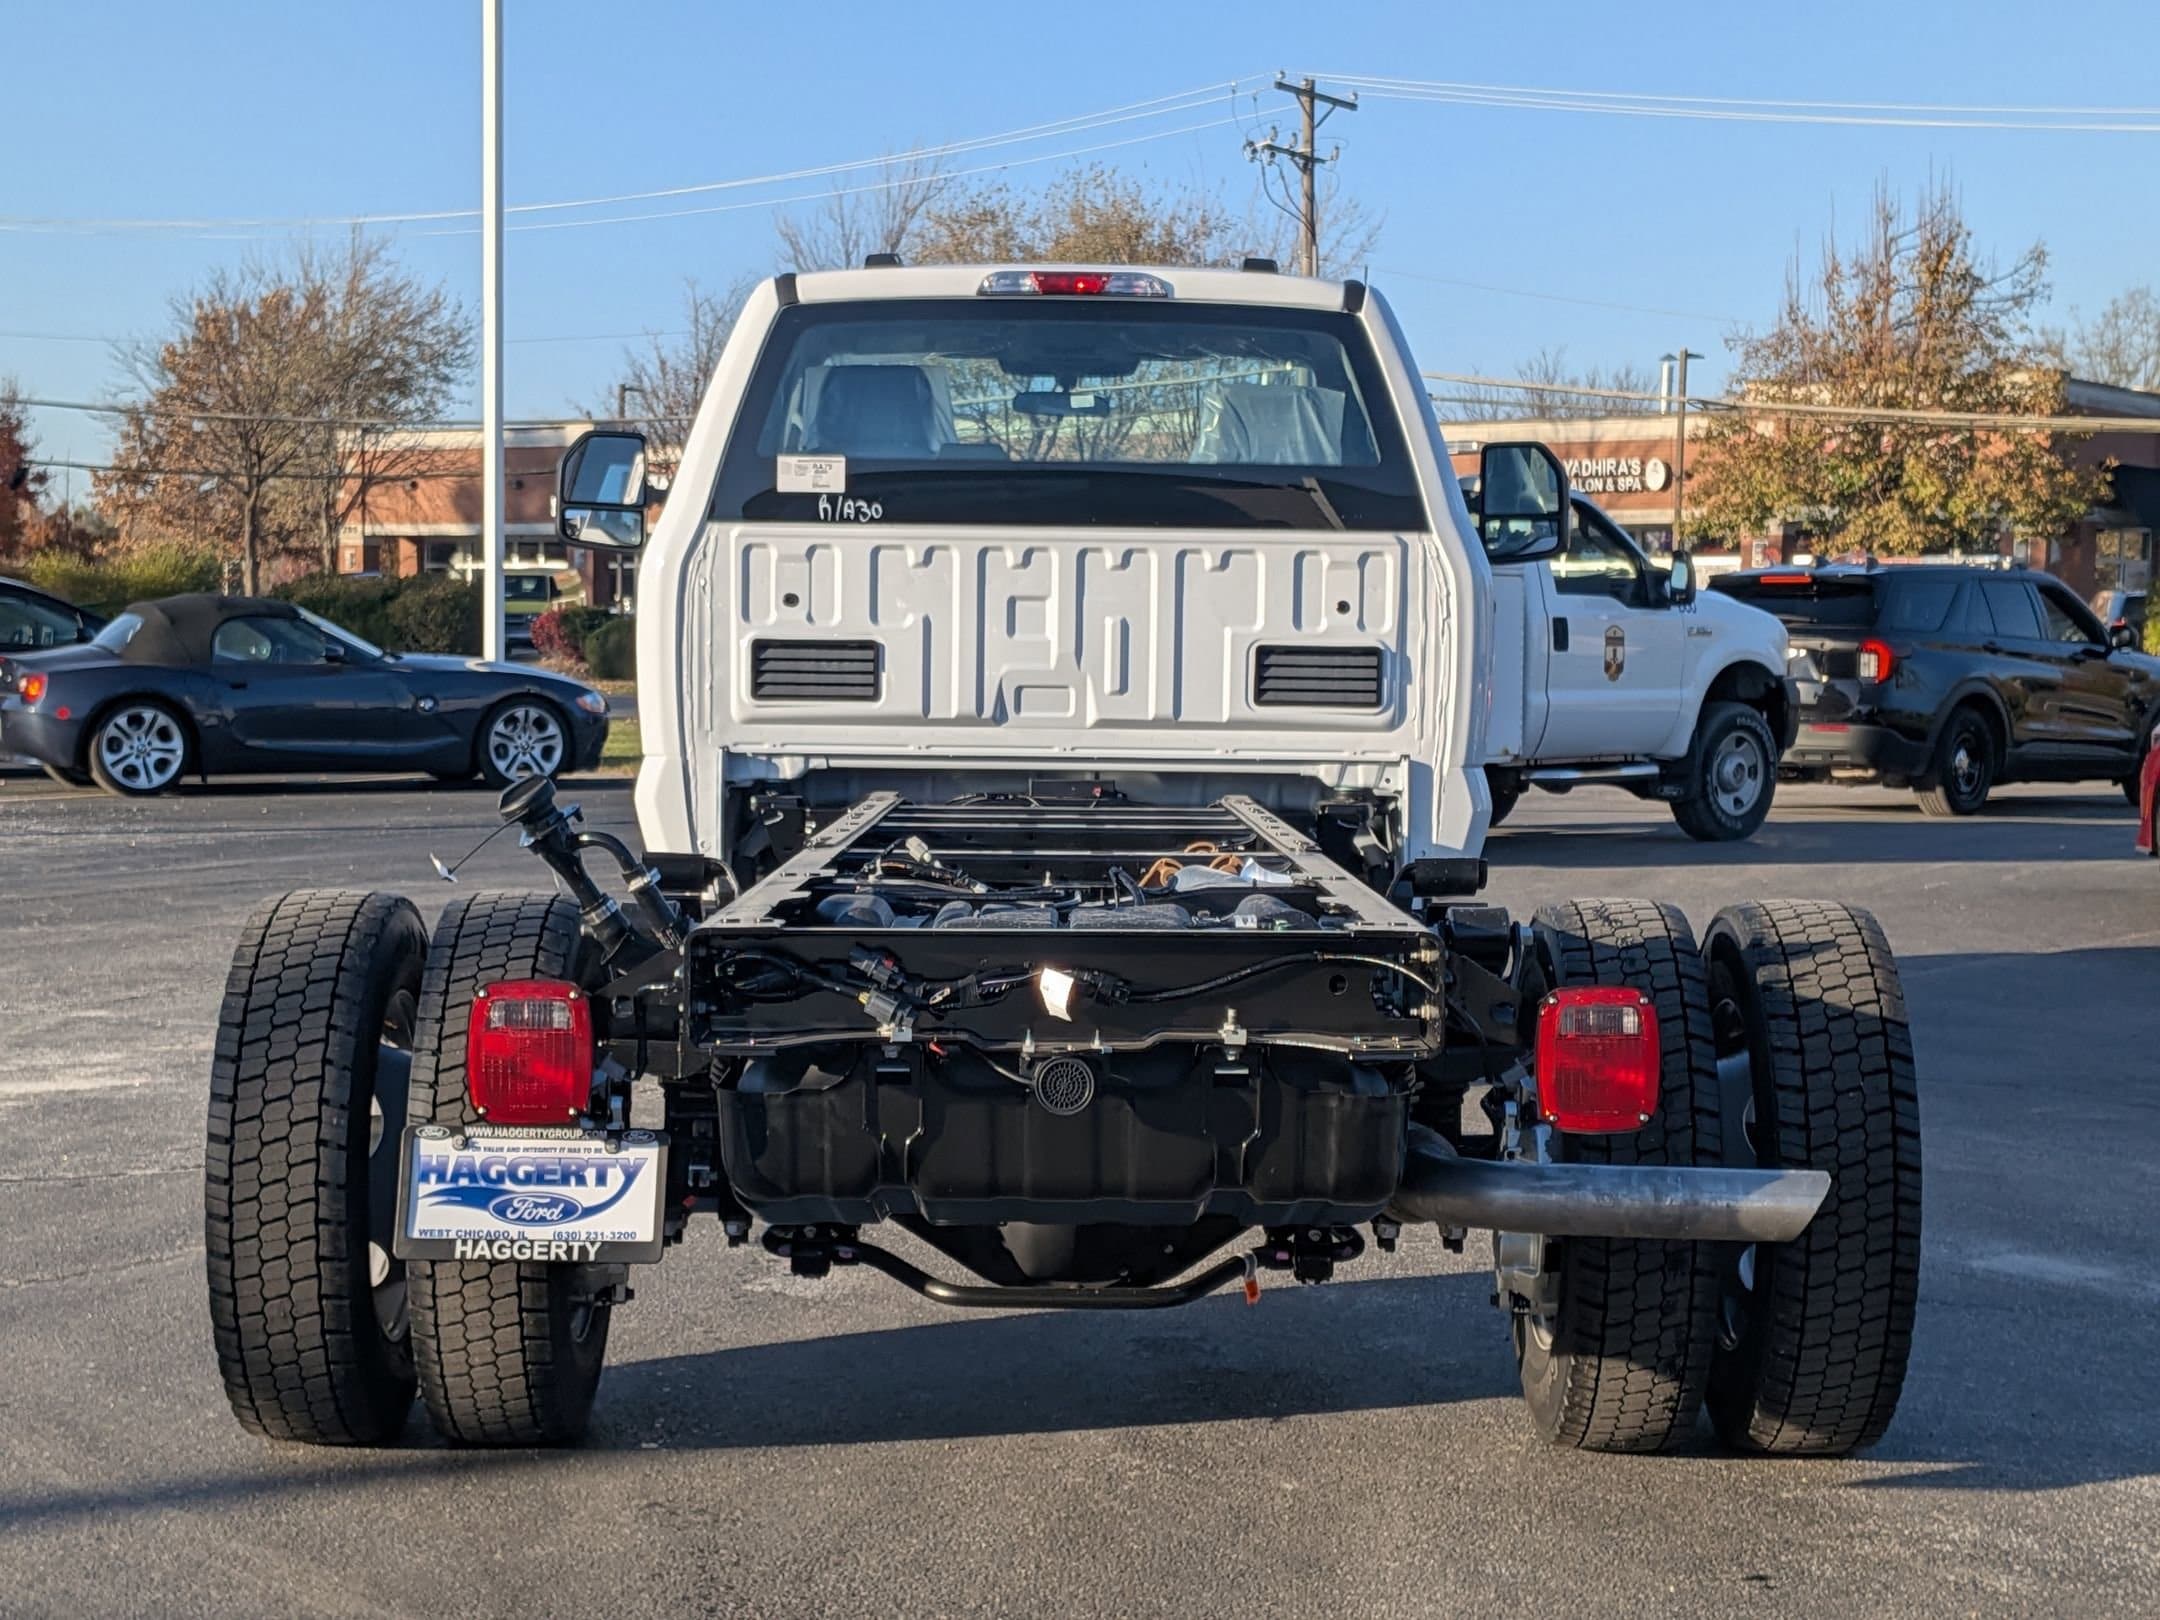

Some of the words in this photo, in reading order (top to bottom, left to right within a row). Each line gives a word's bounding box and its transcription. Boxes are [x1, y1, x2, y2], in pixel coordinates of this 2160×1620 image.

[1563, 457, 1641, 477] YADHIRA'S
[1570, 477, 1604, 492] ALON
[1605, 477, 1615, 491] &
[1617, 476, 1642, 491] SPA
[464, 1125, 607, 1139] WWW.HAGGERTYGROUP.COM
[419, 1154, 648, 1188] HAGGERTY
[503, 1195, 567, 1223] Ford
[418, 1228, 451, 1239] WEST
[516, 1230, 528, 1240] IL
[552, 1230, 582, 1241] (630)
[585, 1231, 637, 1241] 231-3200
[454, 1239, 602, 1262] HAGGERTY
